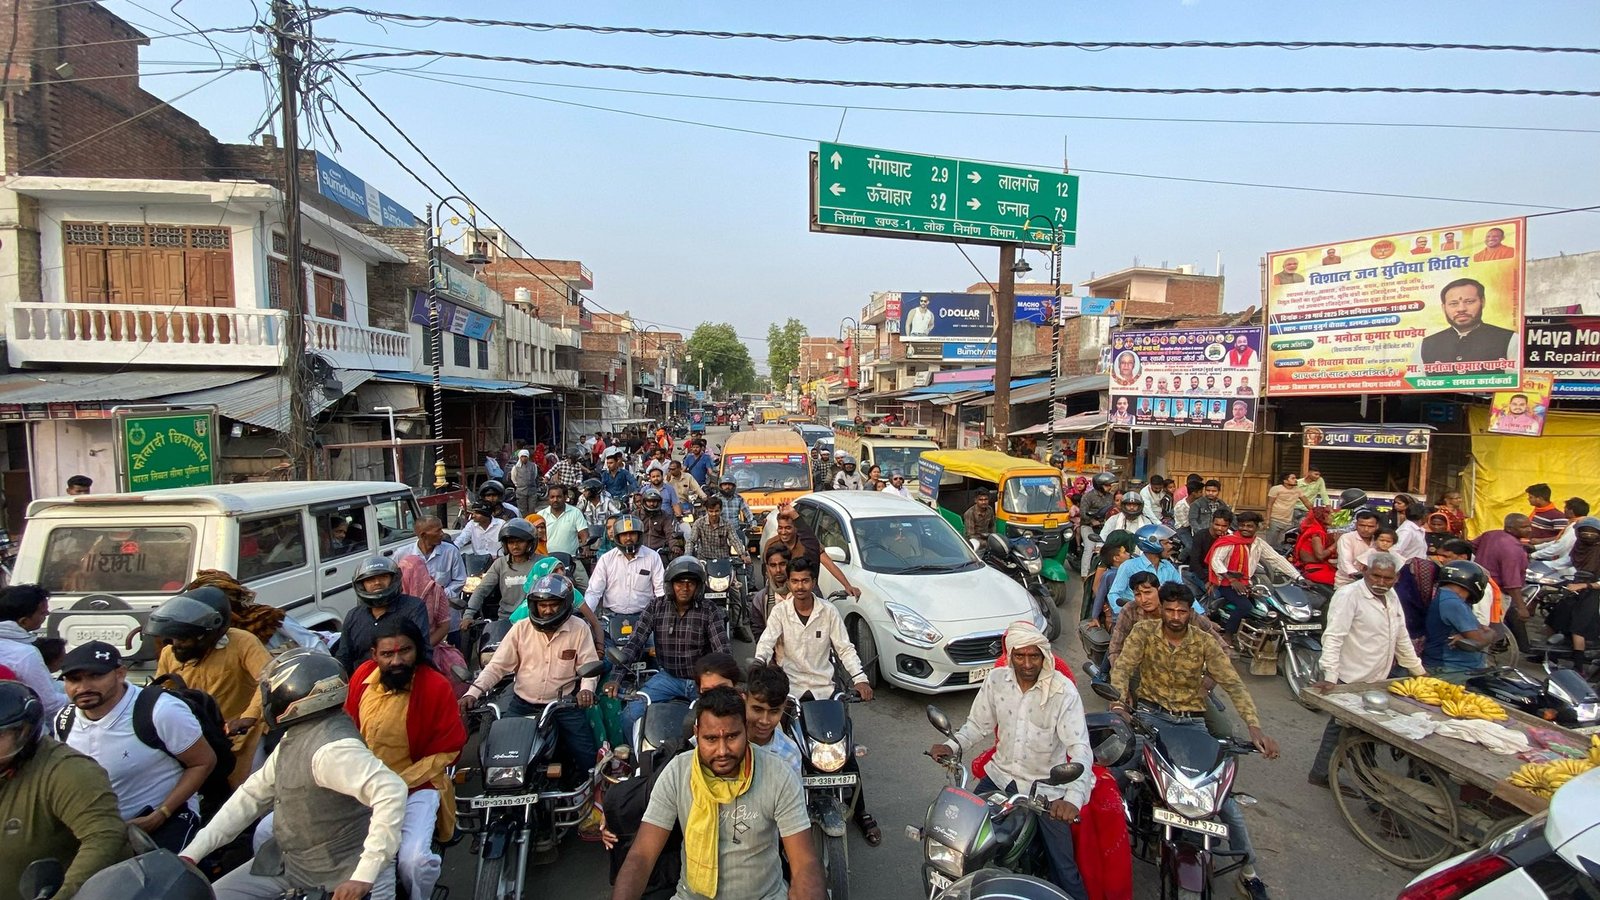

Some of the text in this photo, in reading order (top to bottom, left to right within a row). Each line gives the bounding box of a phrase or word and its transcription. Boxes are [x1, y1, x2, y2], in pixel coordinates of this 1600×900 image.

[867, 154, 949, 183] गंगाघाट 2.9
[998, 174, 1069, 198] लालगंज 12
[866, 183, 947, 212] ऊंचाहार 32
[997, 200, 1067, 222] उन्नाव 79
[834, 210, 866, 225] निर्माण
[923, 220, 945, 232] लोक
[953, 222, 981, 236] निर्माण
[1309, 271, 1352, 285] विशाल
[1354, 267, 1378, 279] जन
[1427, 255, 1470, 272] शिविर
[948, 309, 980, 318] DOLLAR
[1317, 336, 1332, 344] मा.
[1335, 332, 1362, 342] मनोज
[1364, 330, 1390, 342] कुमार
[1394, 327, 1426, 338] पाण्डेय
[1528, 329, 1572, 348] Maya
[1306, 358, 1316, 367] श्री
[1318, 358, 1344, 366] शिवराम
[1346, 357, 1364, 365] रावत
[1530, 351, 1540, 361] &
[1406, 357, 1516, 374] मा. मनोज कुमार पाण्डेय
[1417, 378, 1444, 387] निवेदक
[1452, 378, 1476, 386] समस्त
[1478, 376, 1512, 385] कार्यकर्ता
[1325, 432, 1350, 444] गुप्ता
[1354, 433, 1372, 444] चाट
[132, 432, 165, 470] फौलादी
[133, 474, 148, 483] भारत
[746, 498, 777, 506] CHOOL
[77, 630, 124, 640] BOLERO
[1164, 812, 1174, 820] UP
[1202, 822, 1226, 834] 9273
